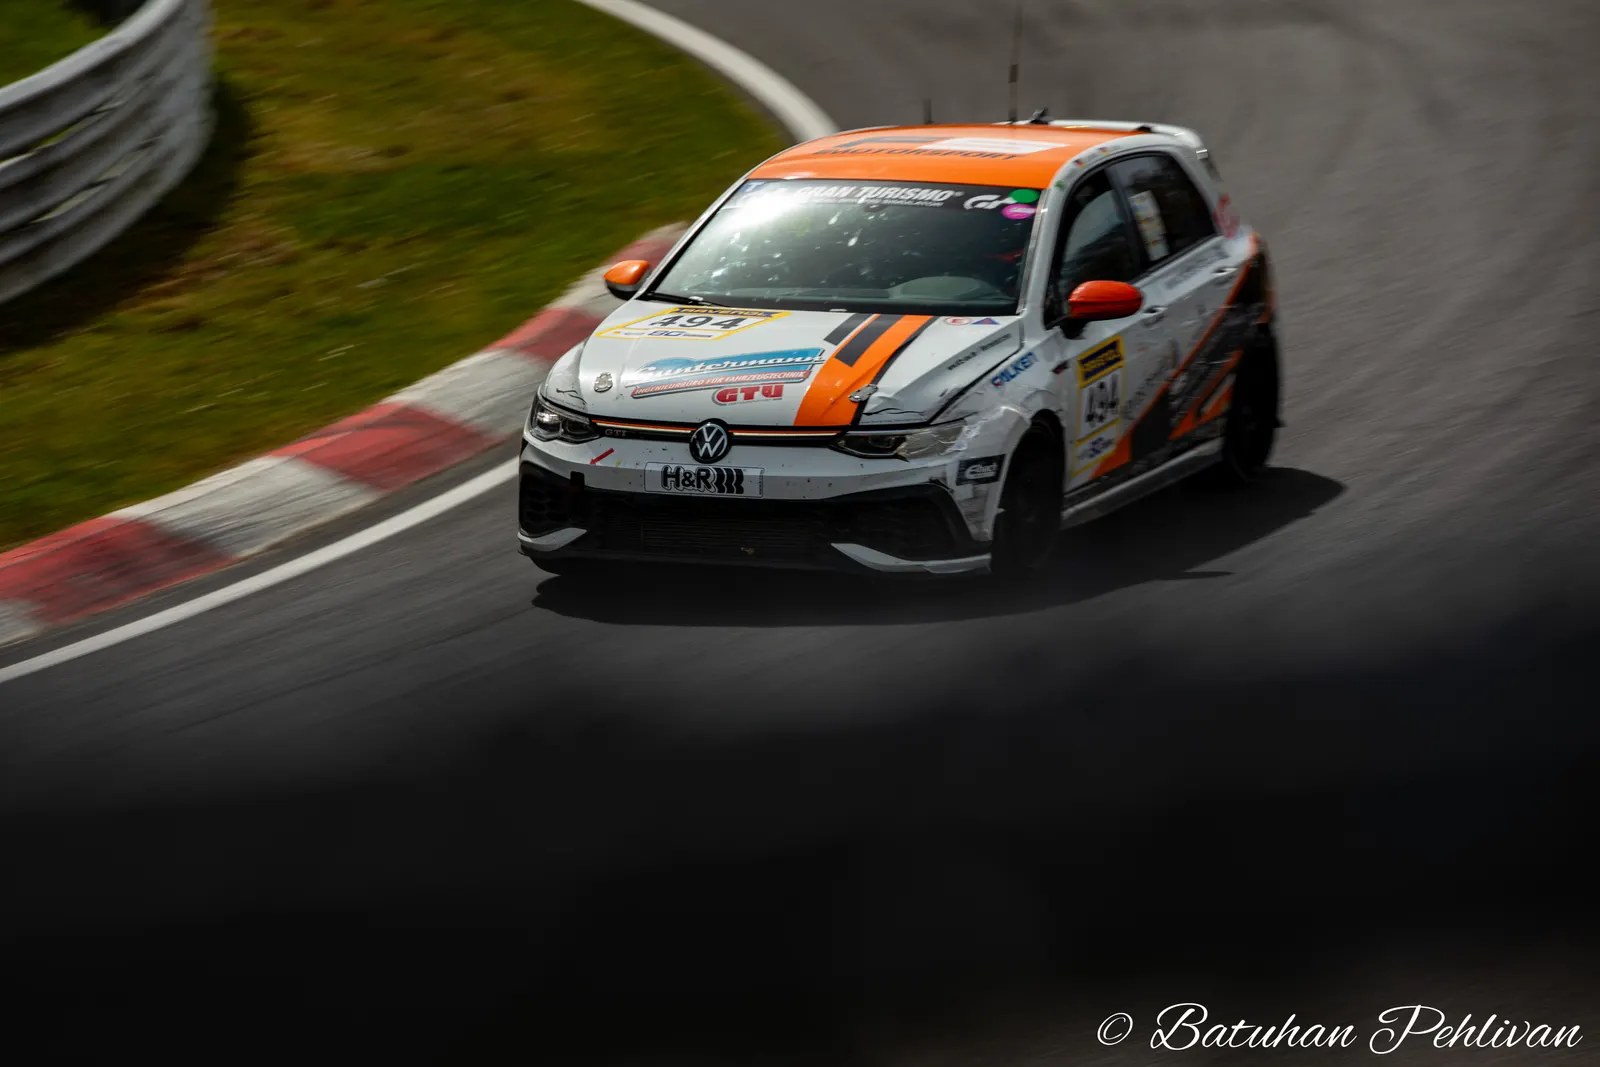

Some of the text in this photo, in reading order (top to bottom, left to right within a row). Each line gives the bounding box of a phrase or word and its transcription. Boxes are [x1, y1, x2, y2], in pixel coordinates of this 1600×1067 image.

[855, 186, 956, 202] TURISMO
[649, 315, 747, 330] 494
[661, 465, 717, 492] H&R
